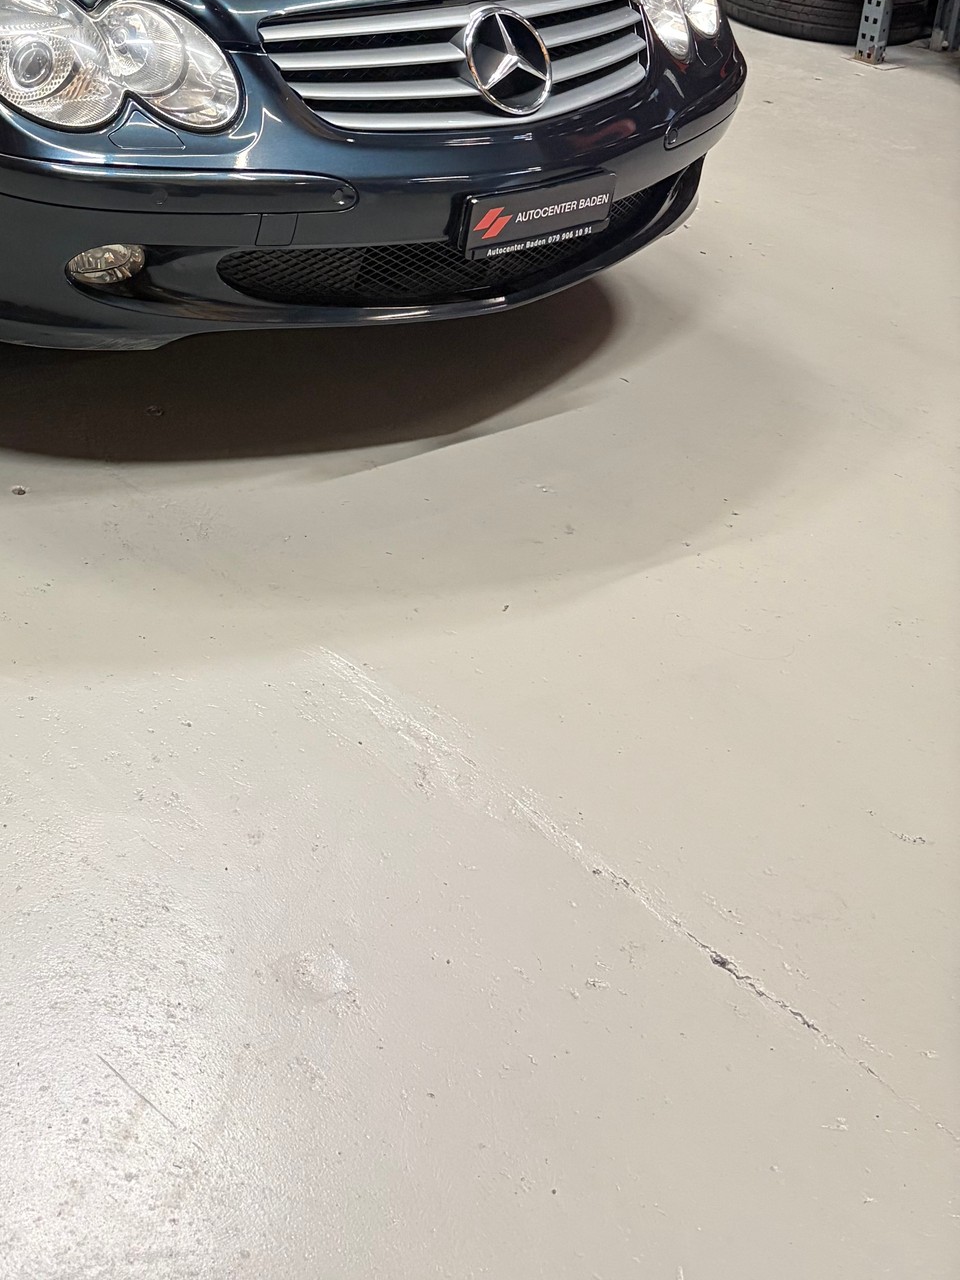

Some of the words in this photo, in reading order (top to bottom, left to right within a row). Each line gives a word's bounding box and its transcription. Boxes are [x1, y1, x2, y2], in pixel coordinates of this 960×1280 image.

[515, 200, 577, 223] AUTOCENTER
[578, 193, 610, 209] BADEN
[486, 243, 525, 257] Autocenter
[526, 238, 546, 249] Baden
